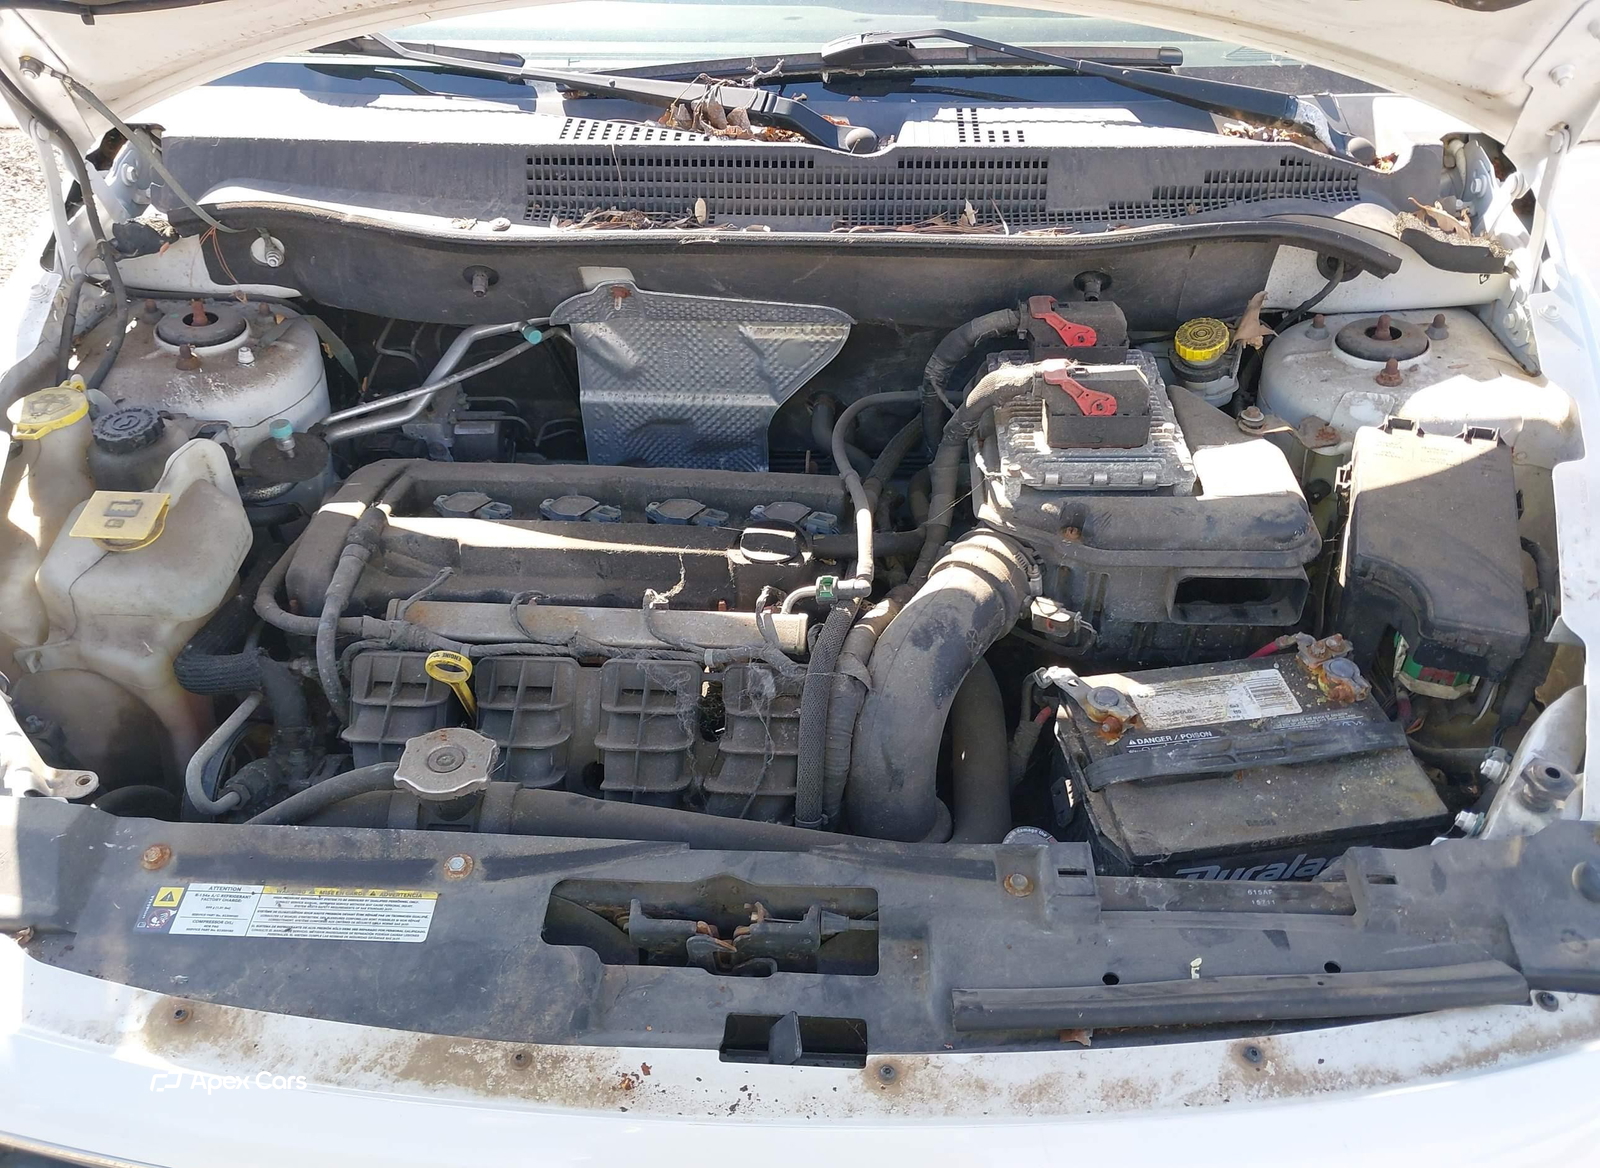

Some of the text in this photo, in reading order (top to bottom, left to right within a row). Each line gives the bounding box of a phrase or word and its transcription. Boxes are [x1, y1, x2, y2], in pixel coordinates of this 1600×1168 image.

[442, 653, 462, 661] ENGINE
[1137, 735, 1172, 745] DANGER
[1180, 731, 1212, 740] POISON
